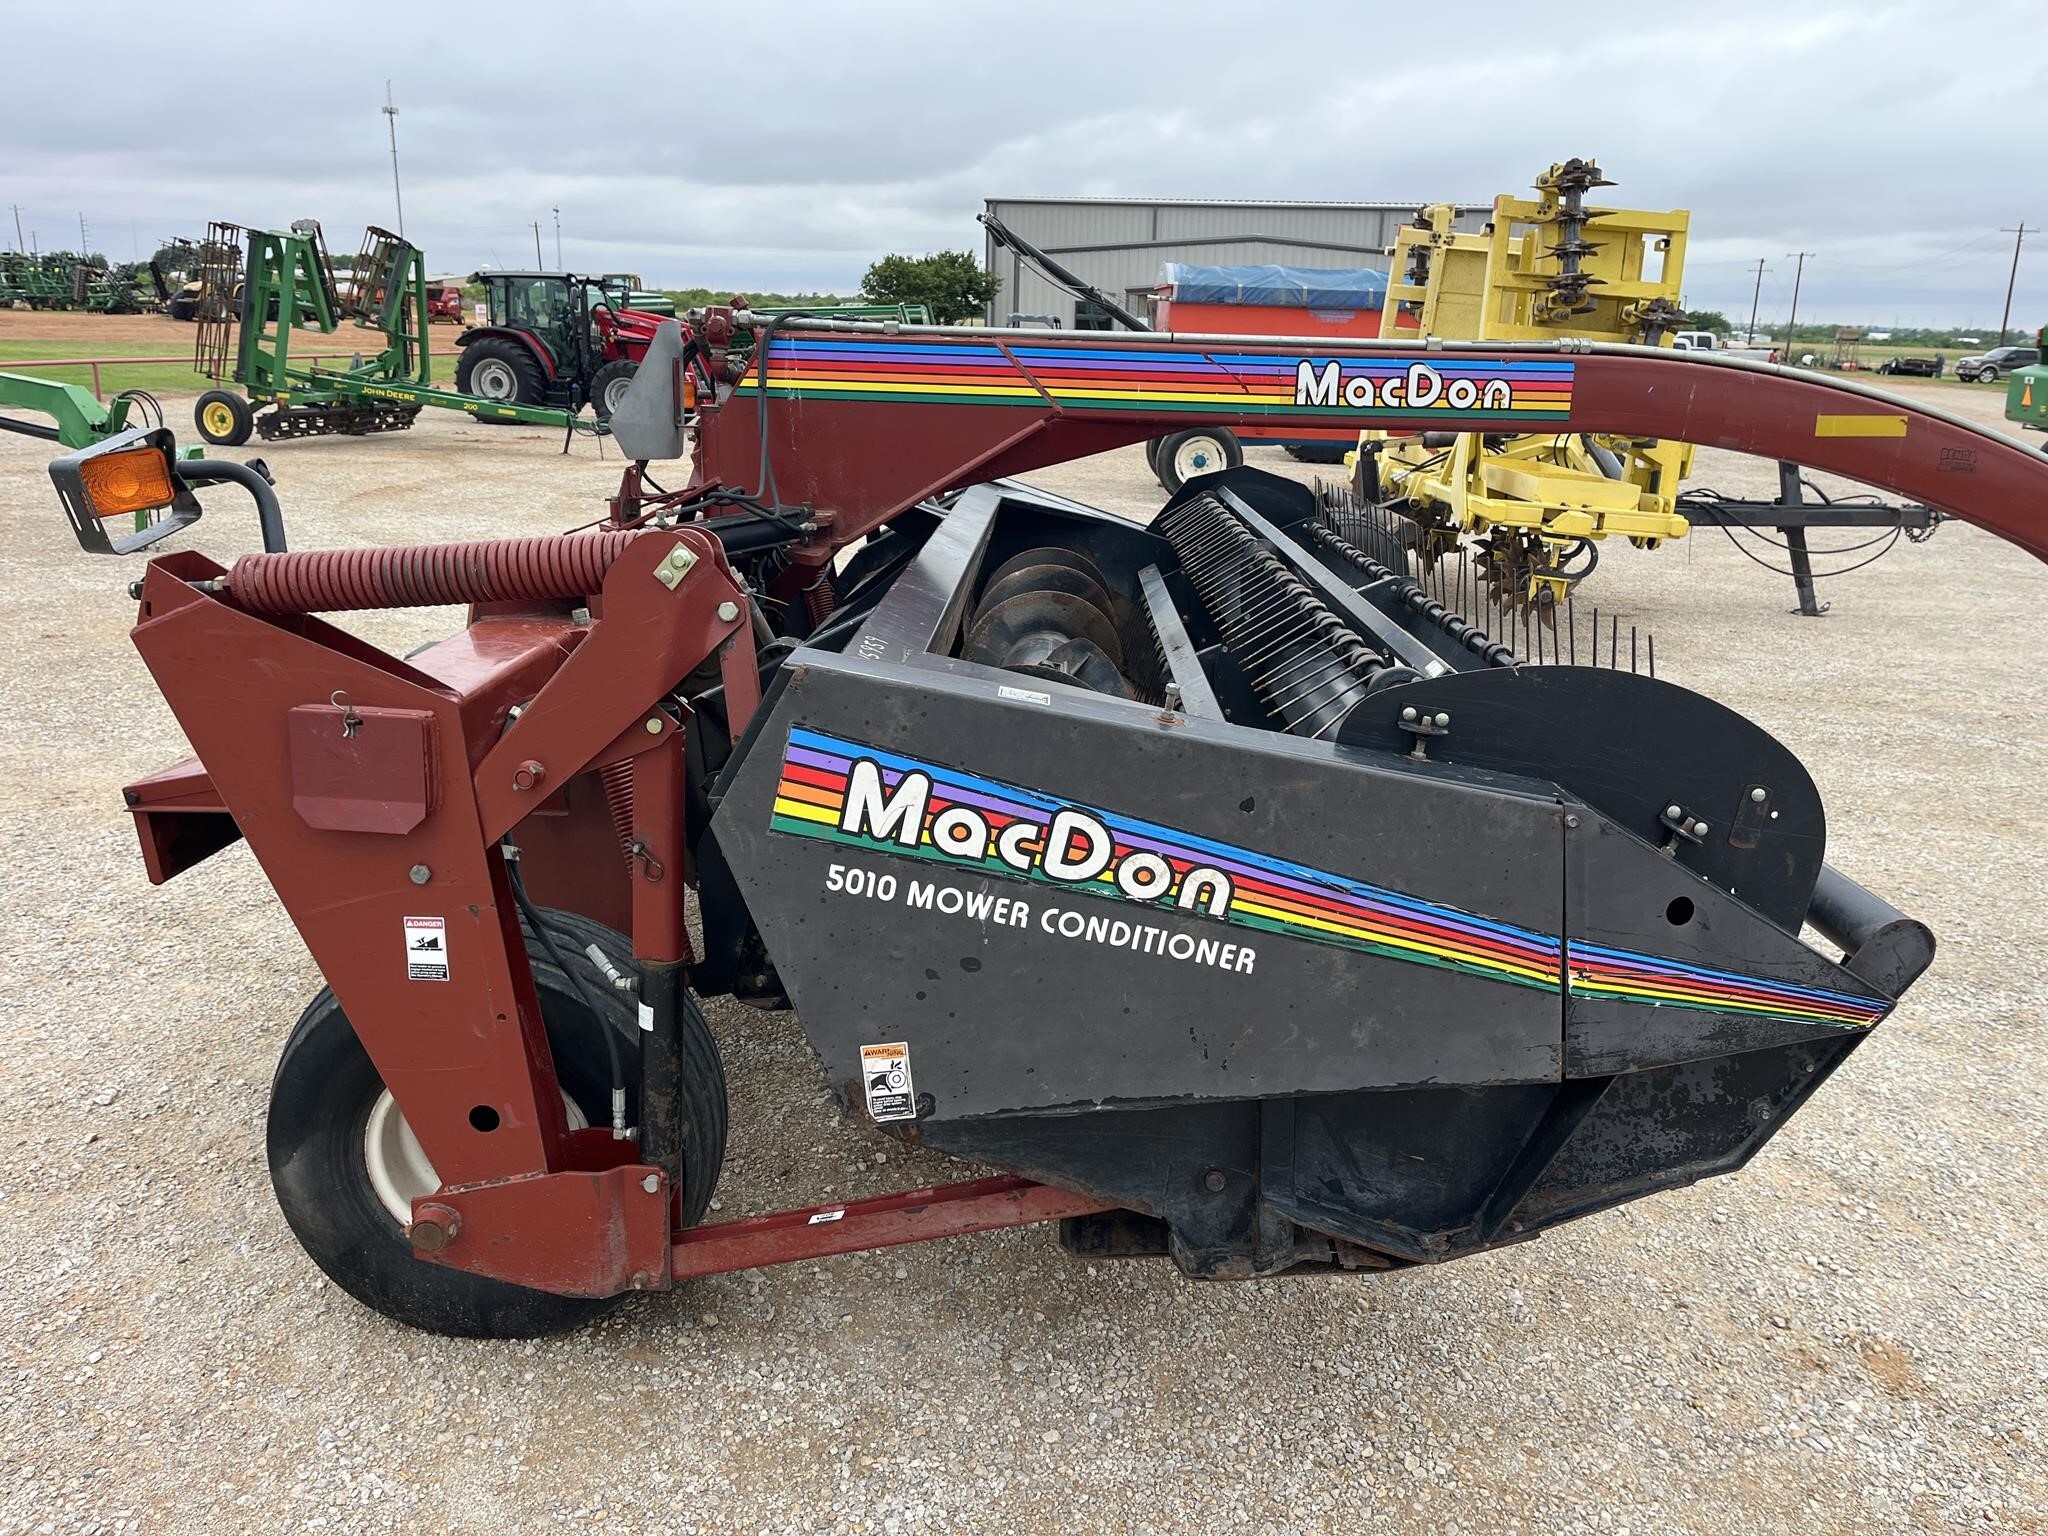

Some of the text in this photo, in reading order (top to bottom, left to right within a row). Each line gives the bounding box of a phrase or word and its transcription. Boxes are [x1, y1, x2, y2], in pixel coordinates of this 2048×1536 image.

[361, 386, 416, 401] JOHN DEERE
[1295, 359, 1513, 409] MacDon
[463, 402, 478, 411] 200
[838, 756, 1236, 919] MacDon
[413, 920, 442, 928] DANGER
[826, 864, 1257, 975] 5010 MOWER CONDITIONER
